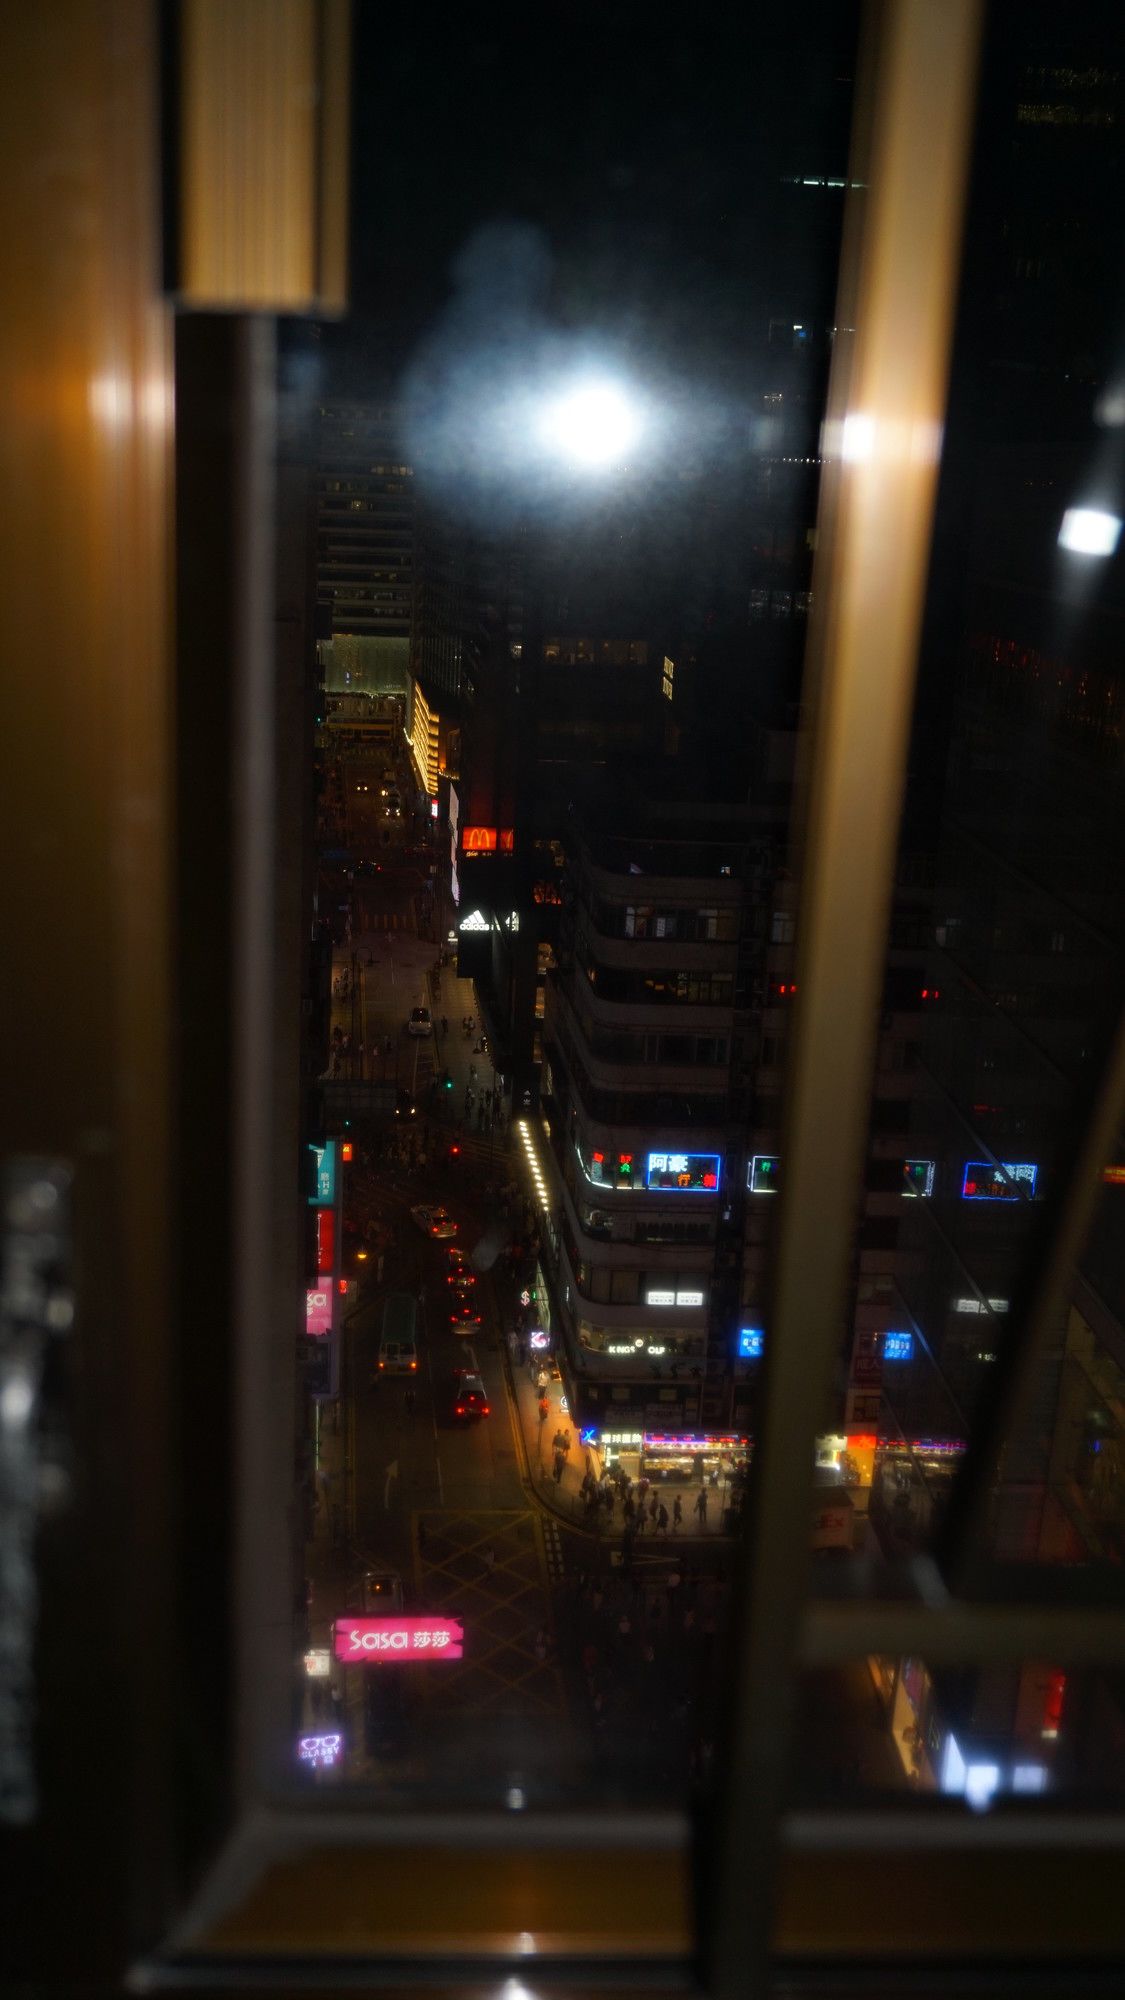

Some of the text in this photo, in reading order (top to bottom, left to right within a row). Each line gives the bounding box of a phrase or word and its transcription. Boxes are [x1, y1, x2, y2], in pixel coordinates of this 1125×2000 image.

[459, 923, 490, 931] adidas
[350, 1630, 451, 1650] Sasa 莎莎
